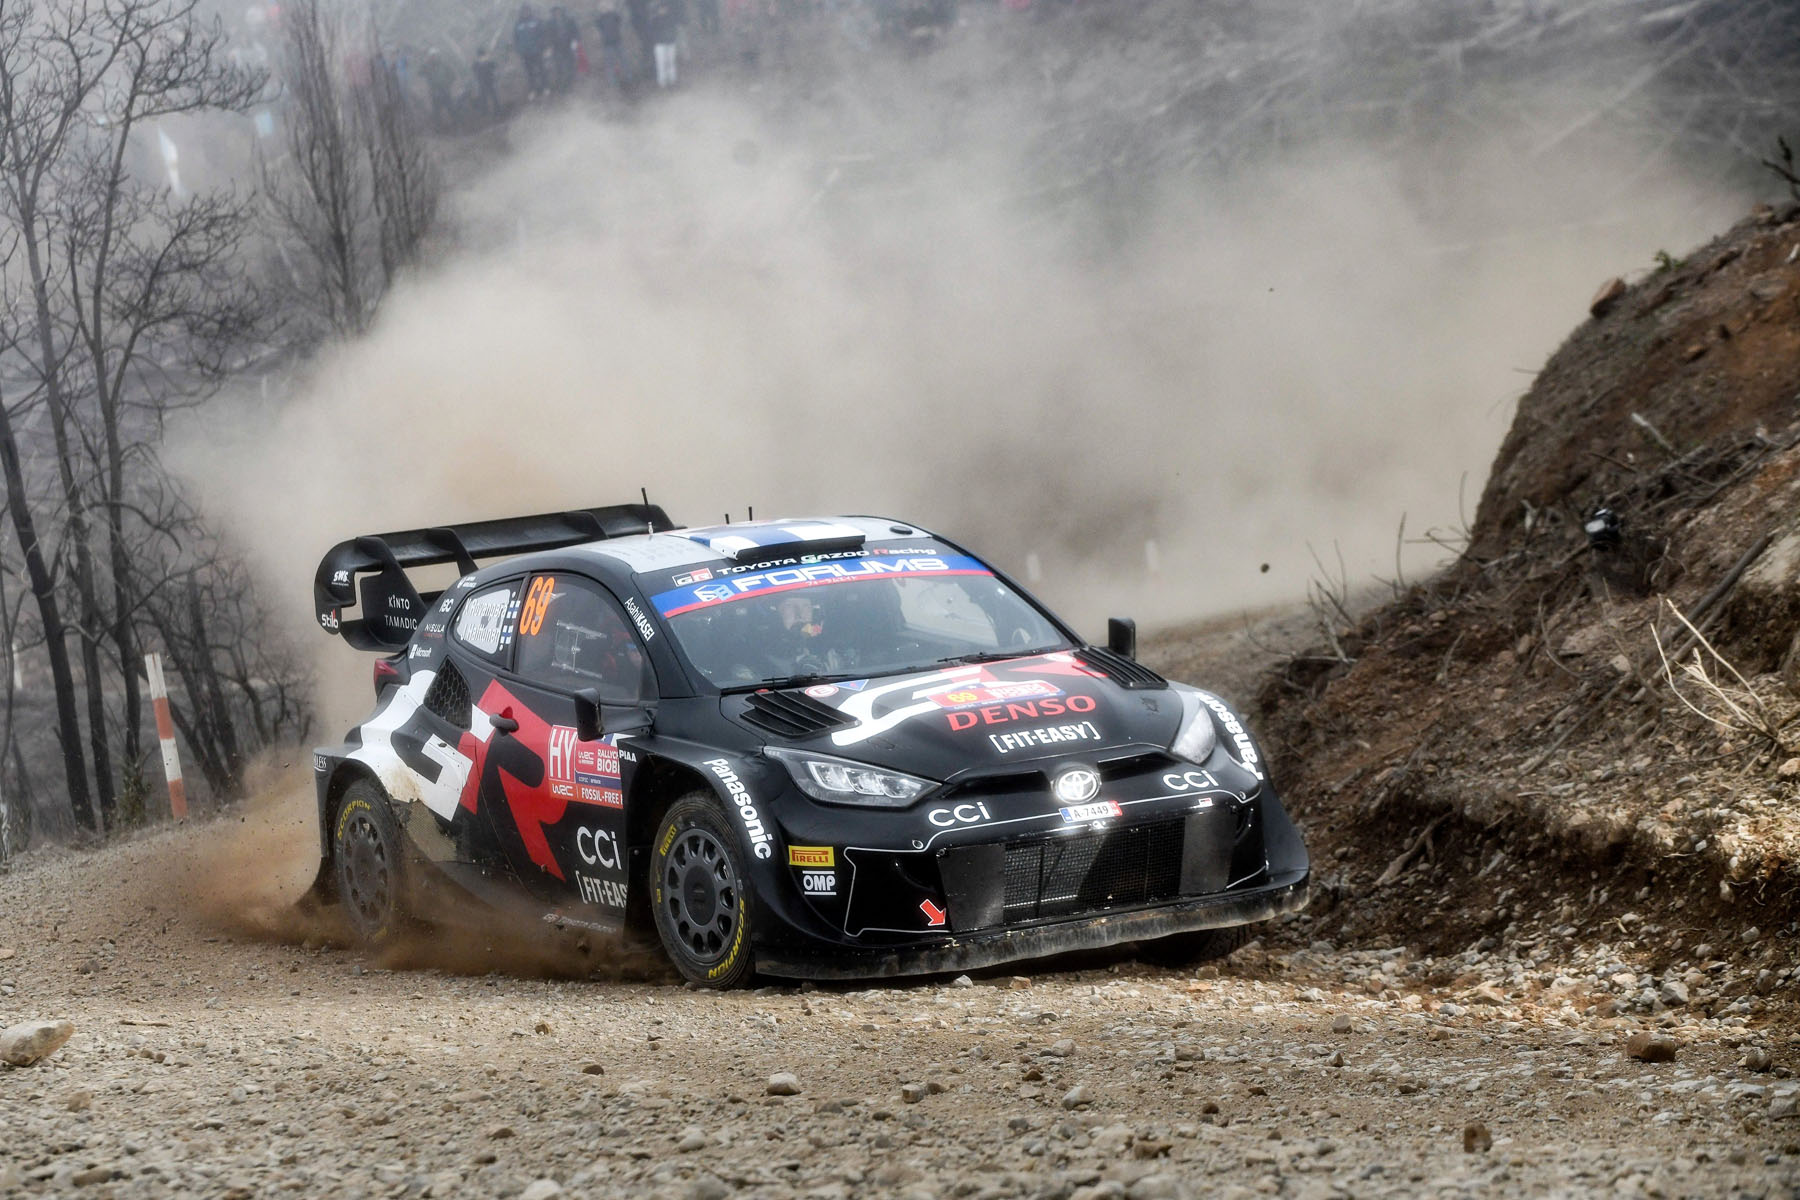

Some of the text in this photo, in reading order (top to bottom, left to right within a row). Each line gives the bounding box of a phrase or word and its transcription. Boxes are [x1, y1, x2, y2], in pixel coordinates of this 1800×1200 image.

[717, 558, 797, 576] TOYOTA
[873, 548, 937, 556] Racing
[731, 557, 949, 593] FORUM8
[321, 608, 339, 629] Stilo
[384, 614, 418, 630] TAMADIC
[519, 576, 555, 636] 69
[624, 596, 655, 642] AsahiKASEI
[946, 695, 1097, 731] DENSO
[549, 728, 578, 780] HY
[618, 749, 637, 762] PIAA
[581, 786, 620, 805] FOSSIL-FREE
[702, 758, 774, 860] Panasonic
[337, 799, 372, 841] SCORPION
[659, 823, 677, 857] PIRELLI
[791, 850, 829, 864] PIRELLI
[803, 874, 836, 892] OMP
[706, 896, 746, 979] SCORPION
